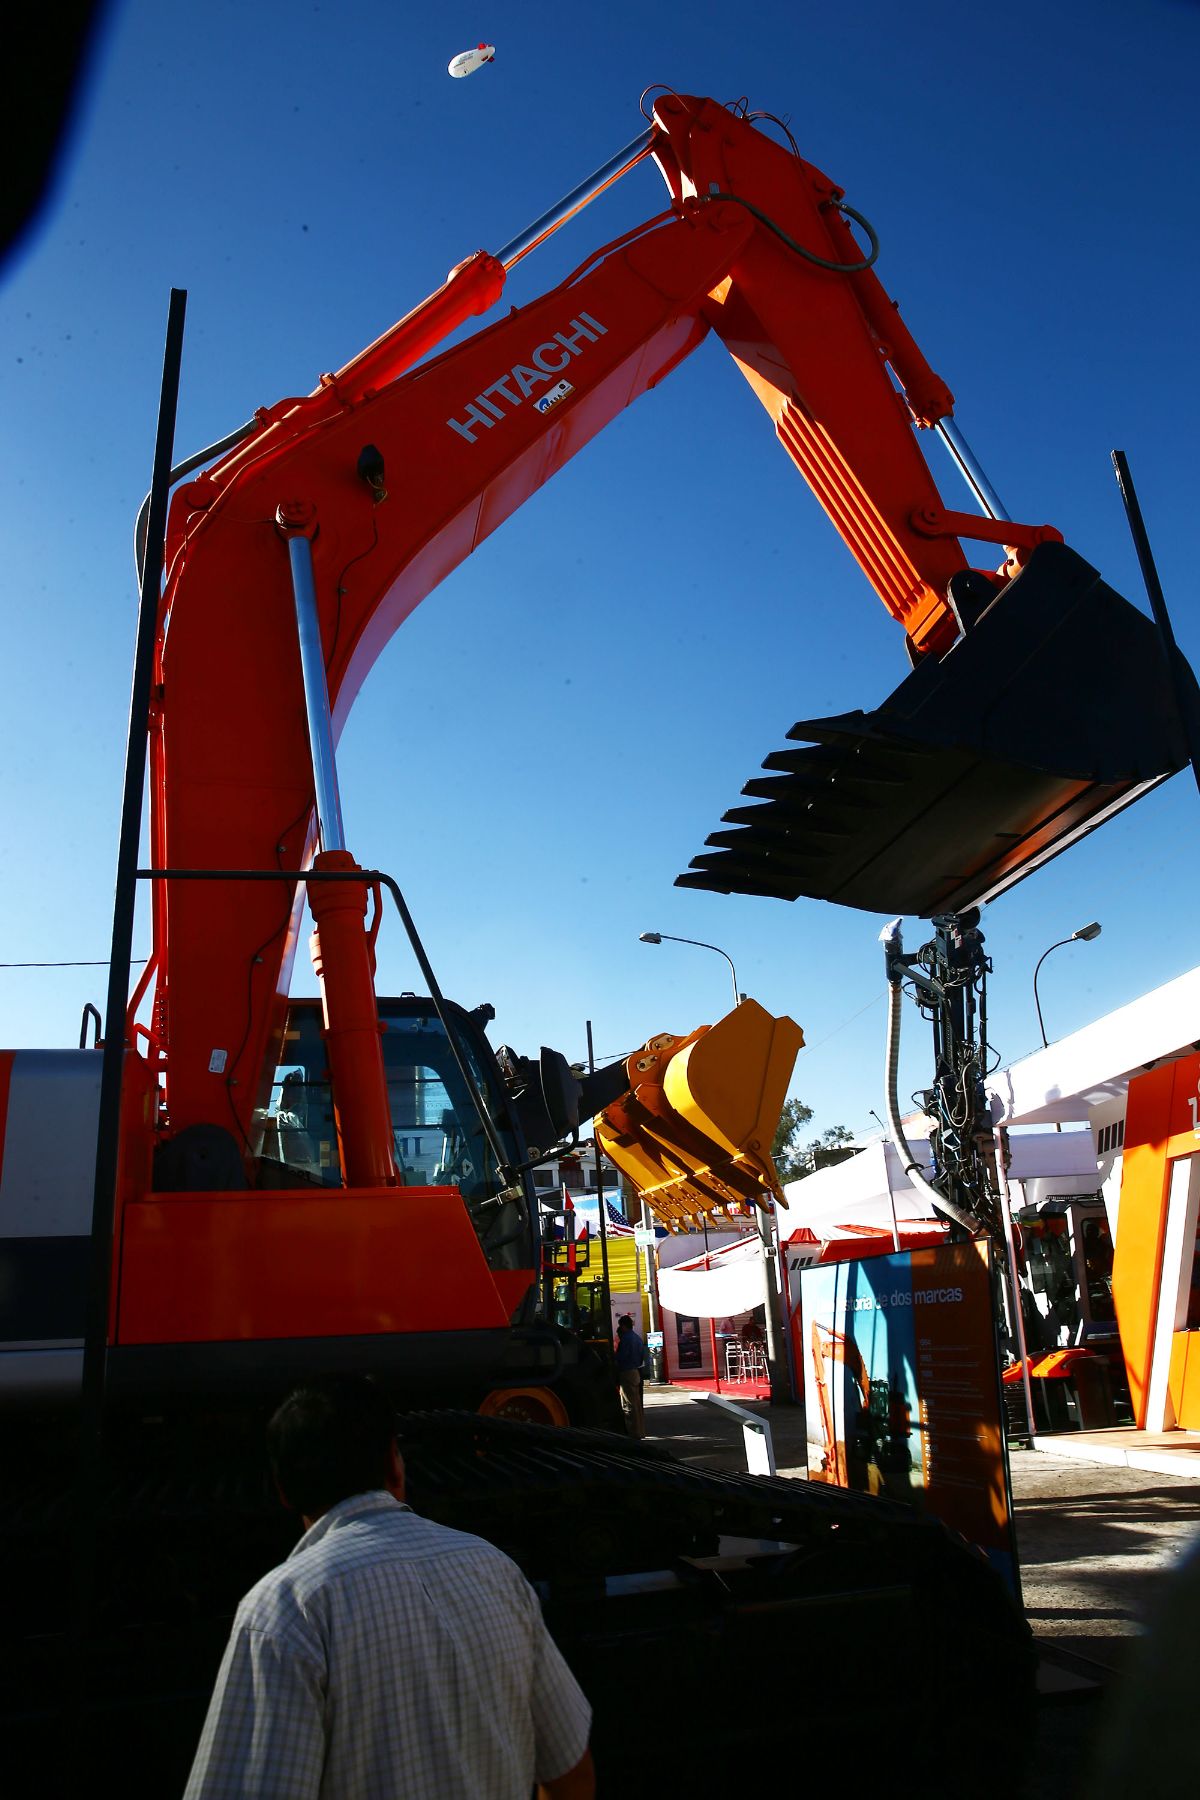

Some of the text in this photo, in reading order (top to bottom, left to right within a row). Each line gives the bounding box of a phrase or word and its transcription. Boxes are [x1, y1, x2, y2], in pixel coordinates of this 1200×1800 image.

[446, 312, 609, 443] HITACHI
[839, 1294, 873, 1311] storia
[875, 1293, 888, 1309] de
[891, 1290, 912, 1306] dos
[915, 1287, 963, 1304] marcas
